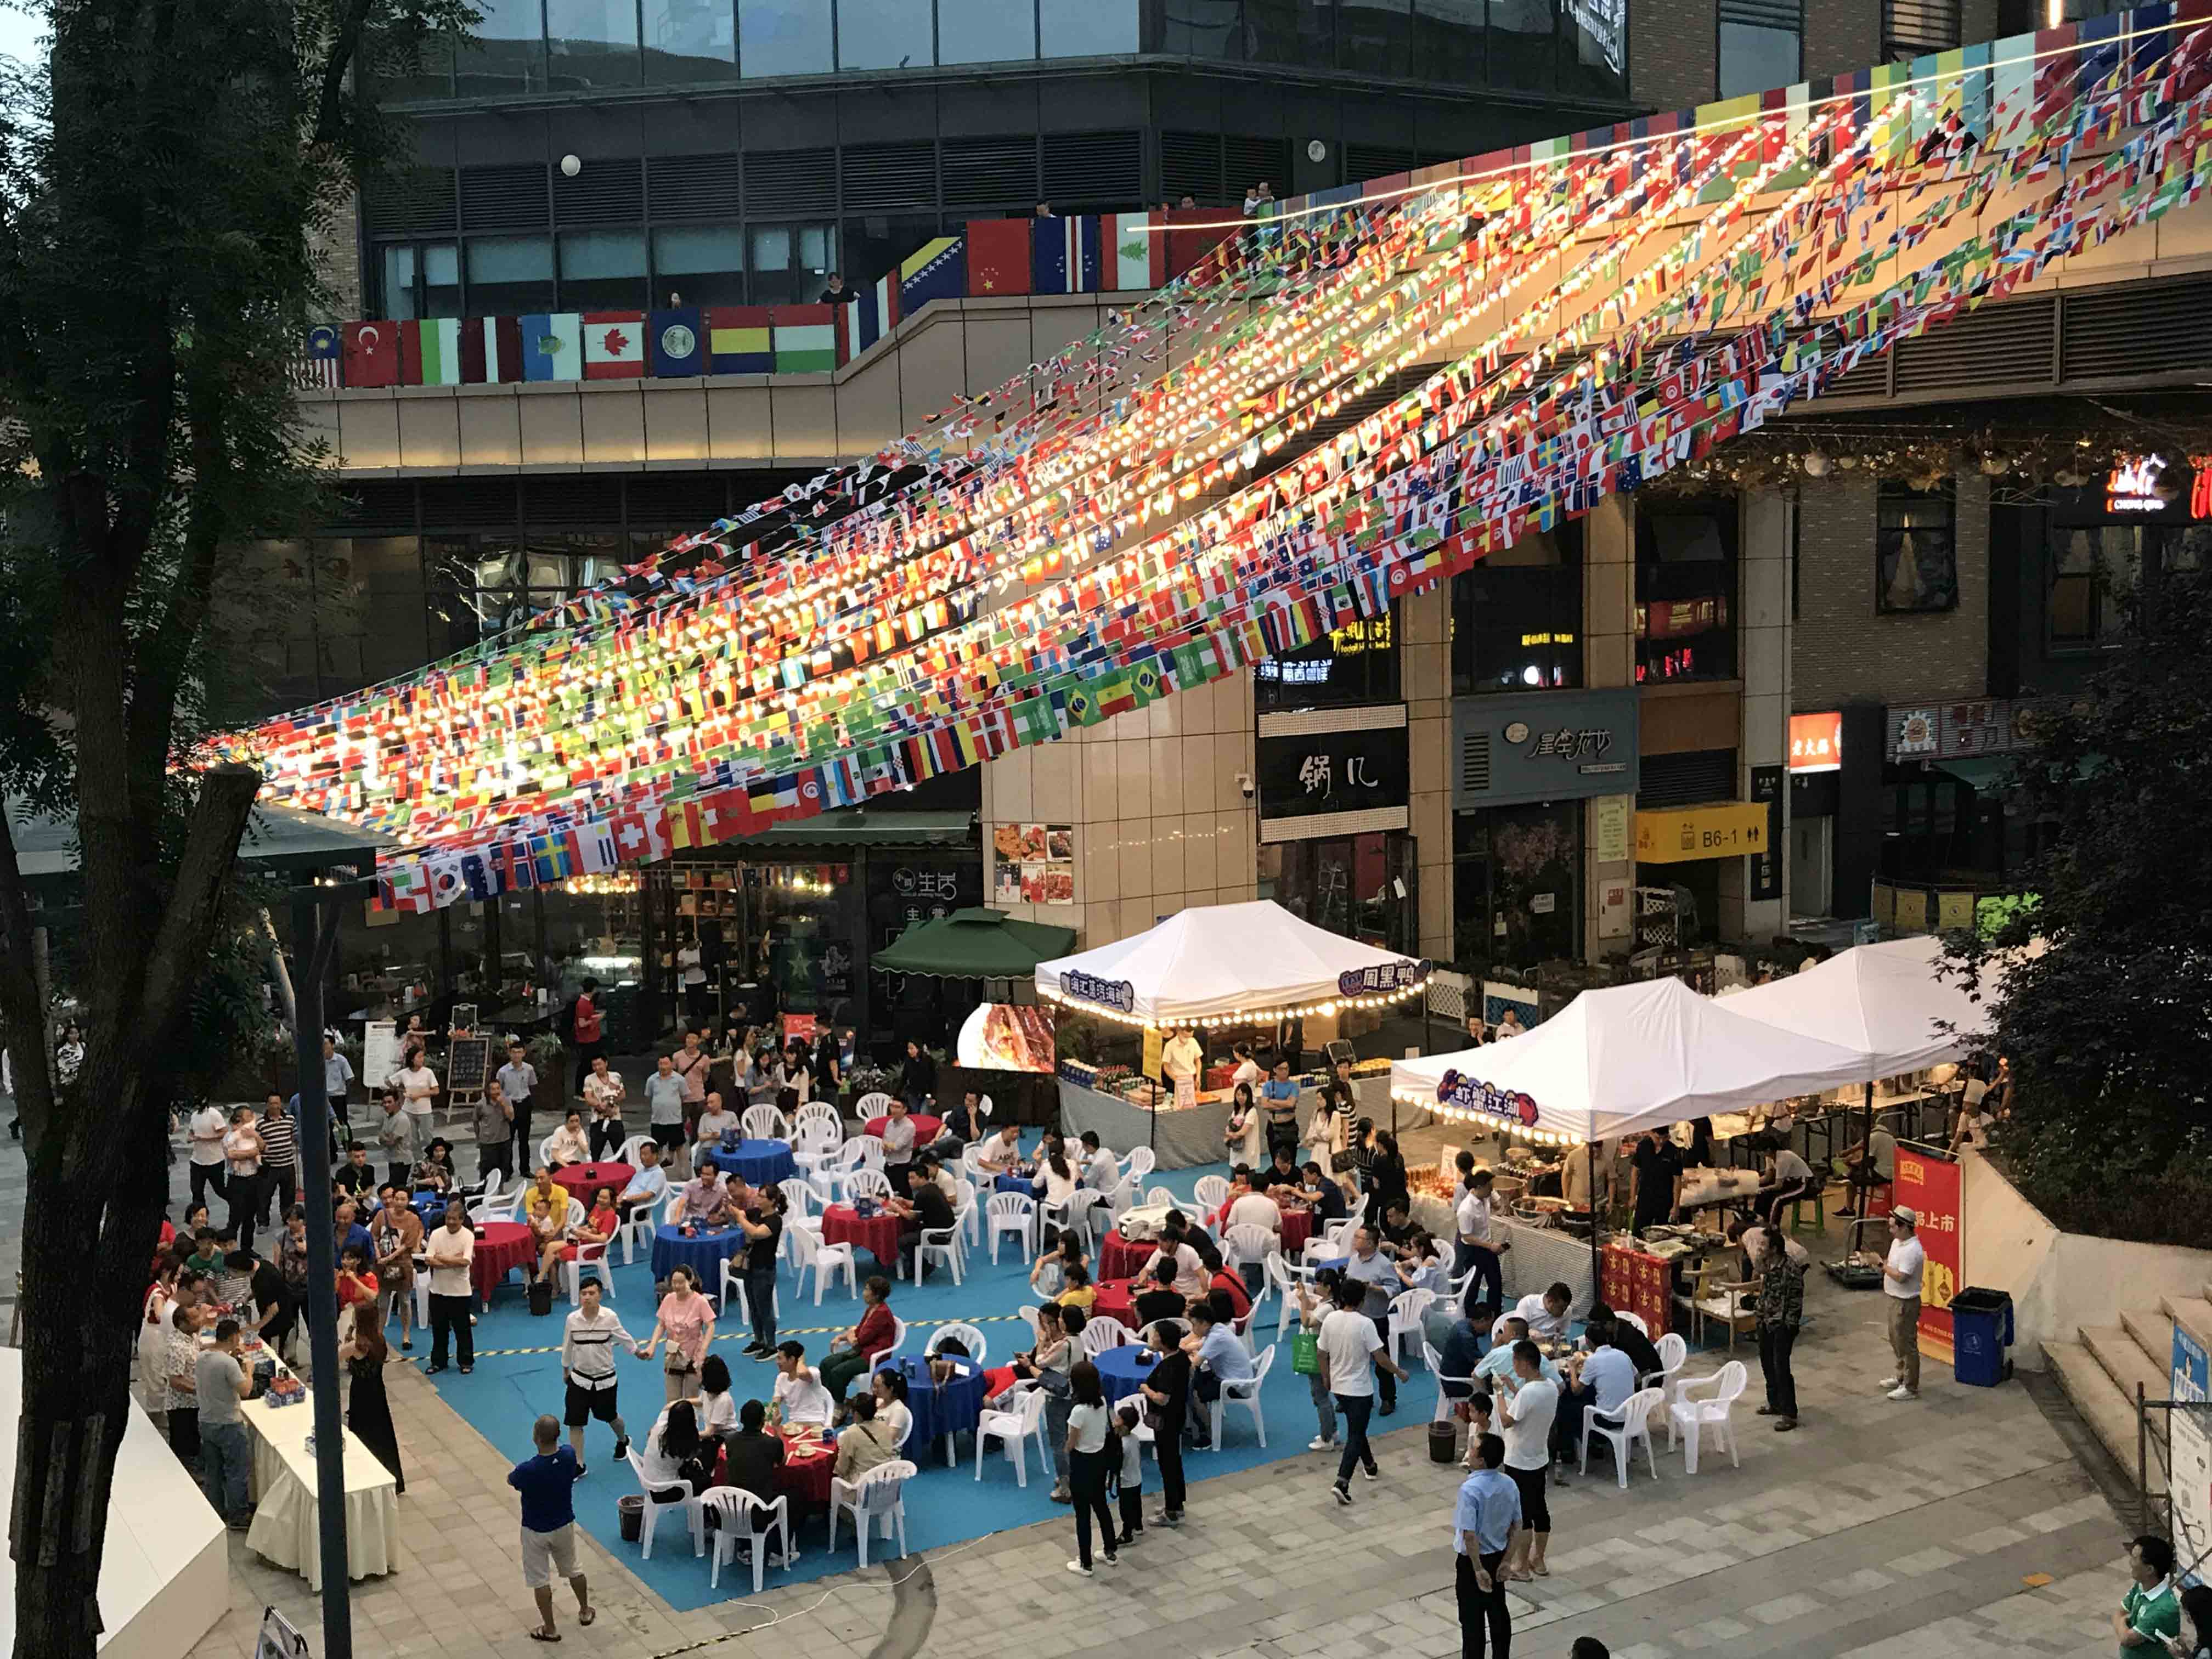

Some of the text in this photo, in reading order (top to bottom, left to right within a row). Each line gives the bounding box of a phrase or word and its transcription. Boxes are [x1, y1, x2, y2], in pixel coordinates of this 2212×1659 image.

[1702, 828, 1738, 848] B6-1
[1363, 964, 1415, 988] 周黑鸭
[1455, 1085, 1519, 1117] 虾蟹江湖
[1913, 1211, 1955, 1232] 品上市
